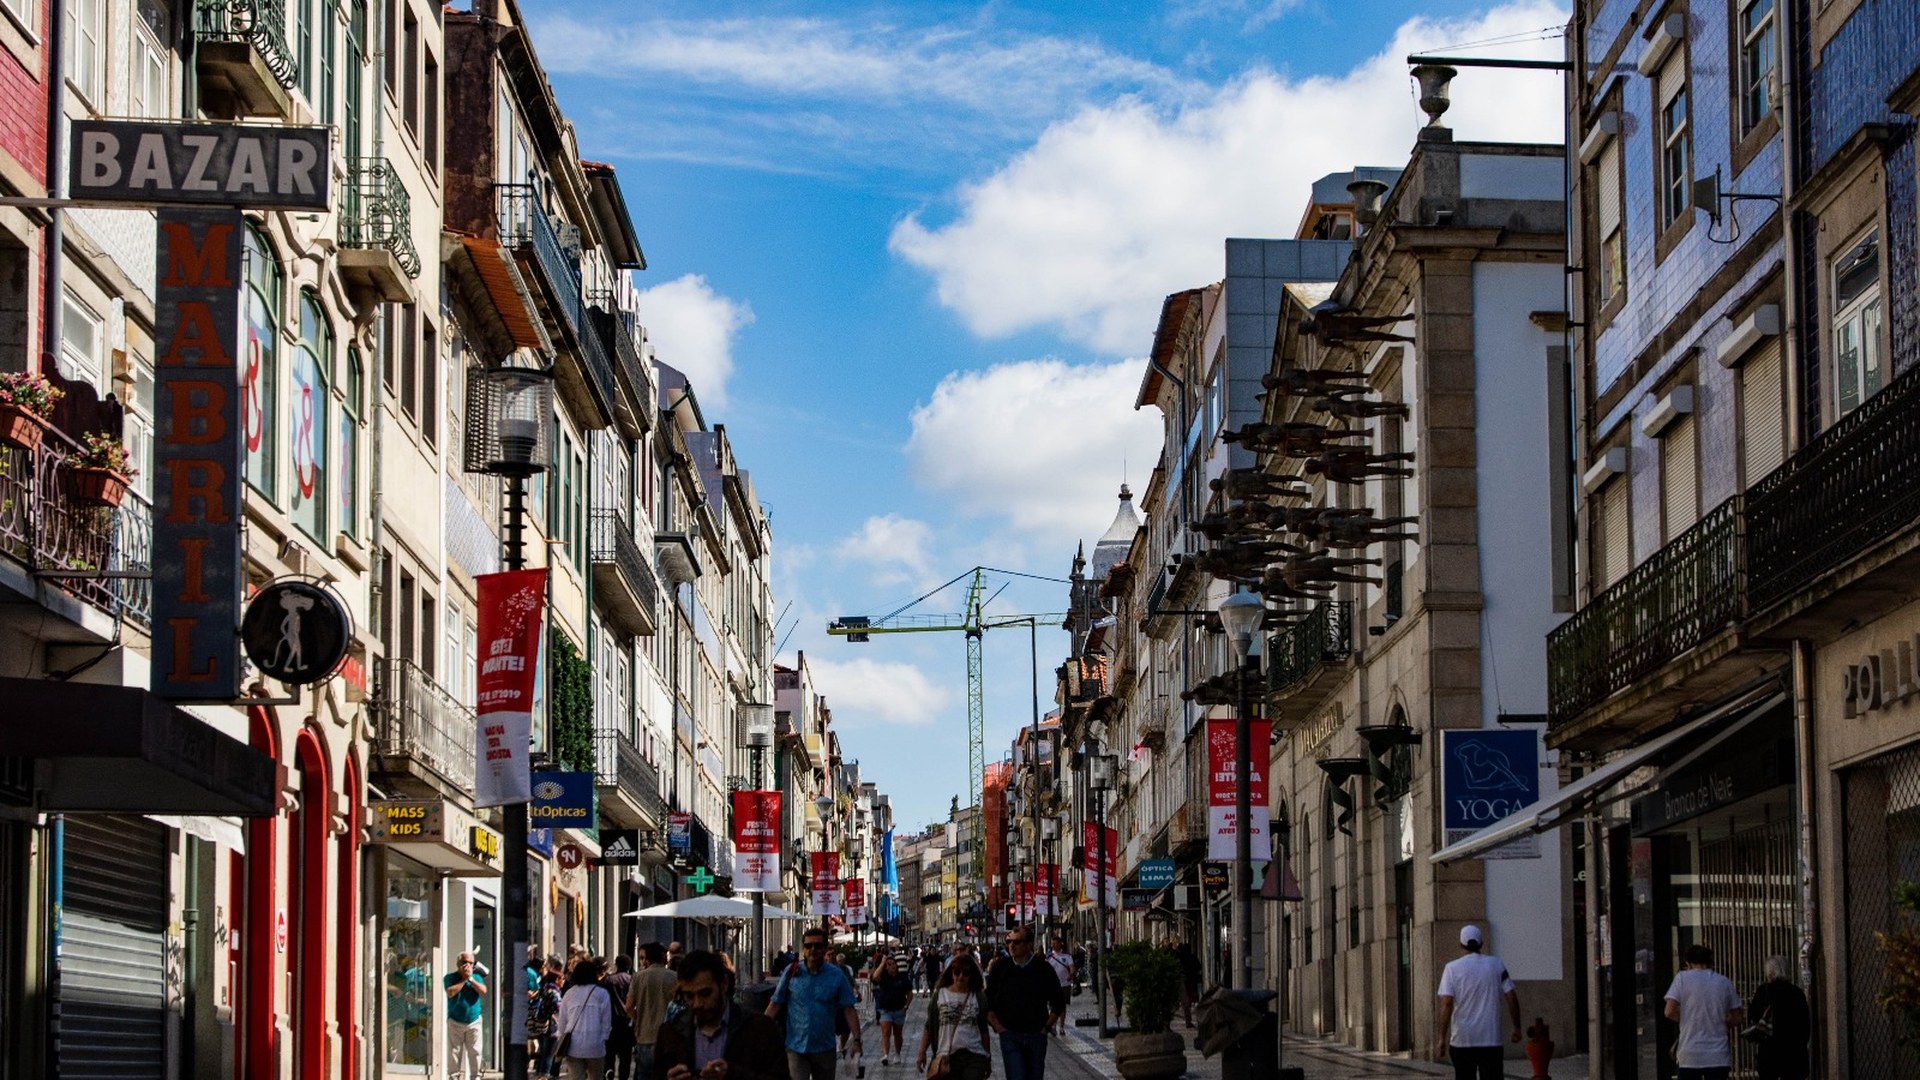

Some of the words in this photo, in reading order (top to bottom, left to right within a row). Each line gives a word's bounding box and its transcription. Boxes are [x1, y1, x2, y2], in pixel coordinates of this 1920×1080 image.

[80, 131, 318, 195] BAZAR
[160, 222, 235, 683] MABRIL
[1697, 775, 1709, 808] de
[1709, 771, 1733, 804] Neve
[387, 806, 426, 818] MASS
[530, 805, 587, 819] ltiOpticas
[1456, 798, 1523, 820] YOGA
[390, 823, 422, 835] KIDS
[604, 849, 636, 858] adidas
